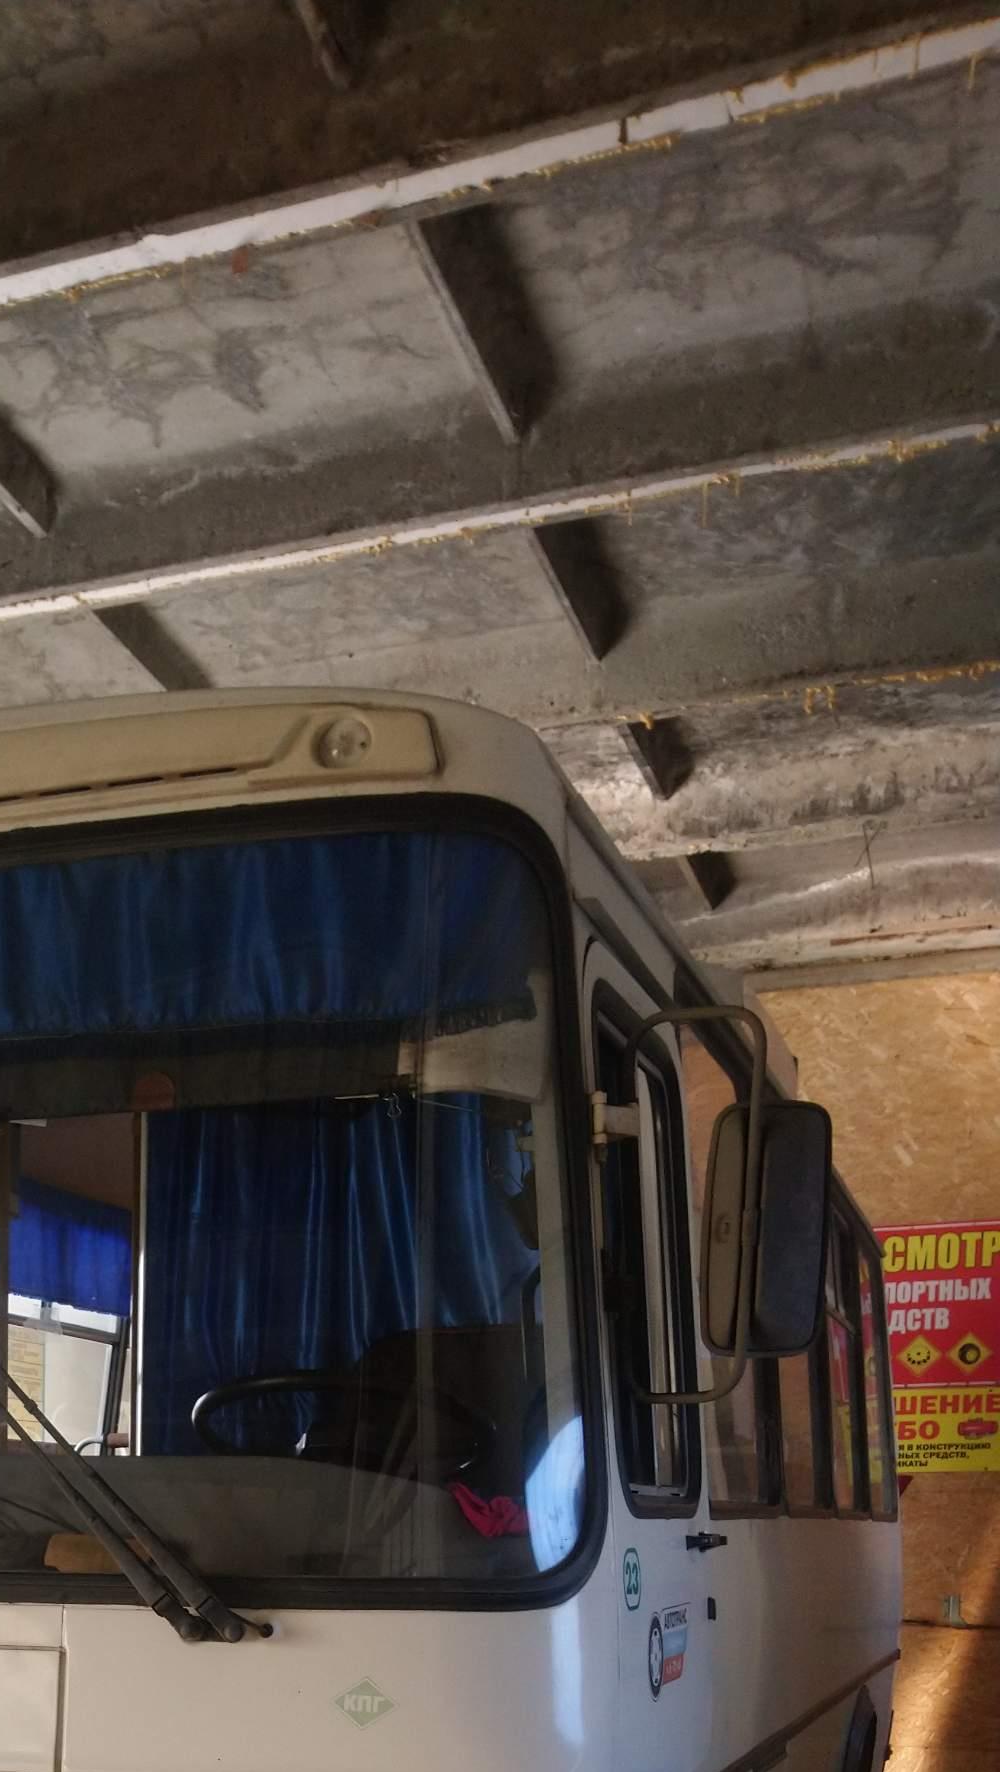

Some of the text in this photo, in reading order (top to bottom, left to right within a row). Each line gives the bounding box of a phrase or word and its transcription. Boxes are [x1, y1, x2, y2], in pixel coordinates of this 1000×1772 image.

[883, 1230, 1000, 1273] СМОТР
[885, 1277, 991, 1304] ПОРТНЫХ
[888, 1307, 950, 1334] ДСТВ
[625, 1561, 639, 1595] 23
[344, 1695, 384, 1712] КПГ
